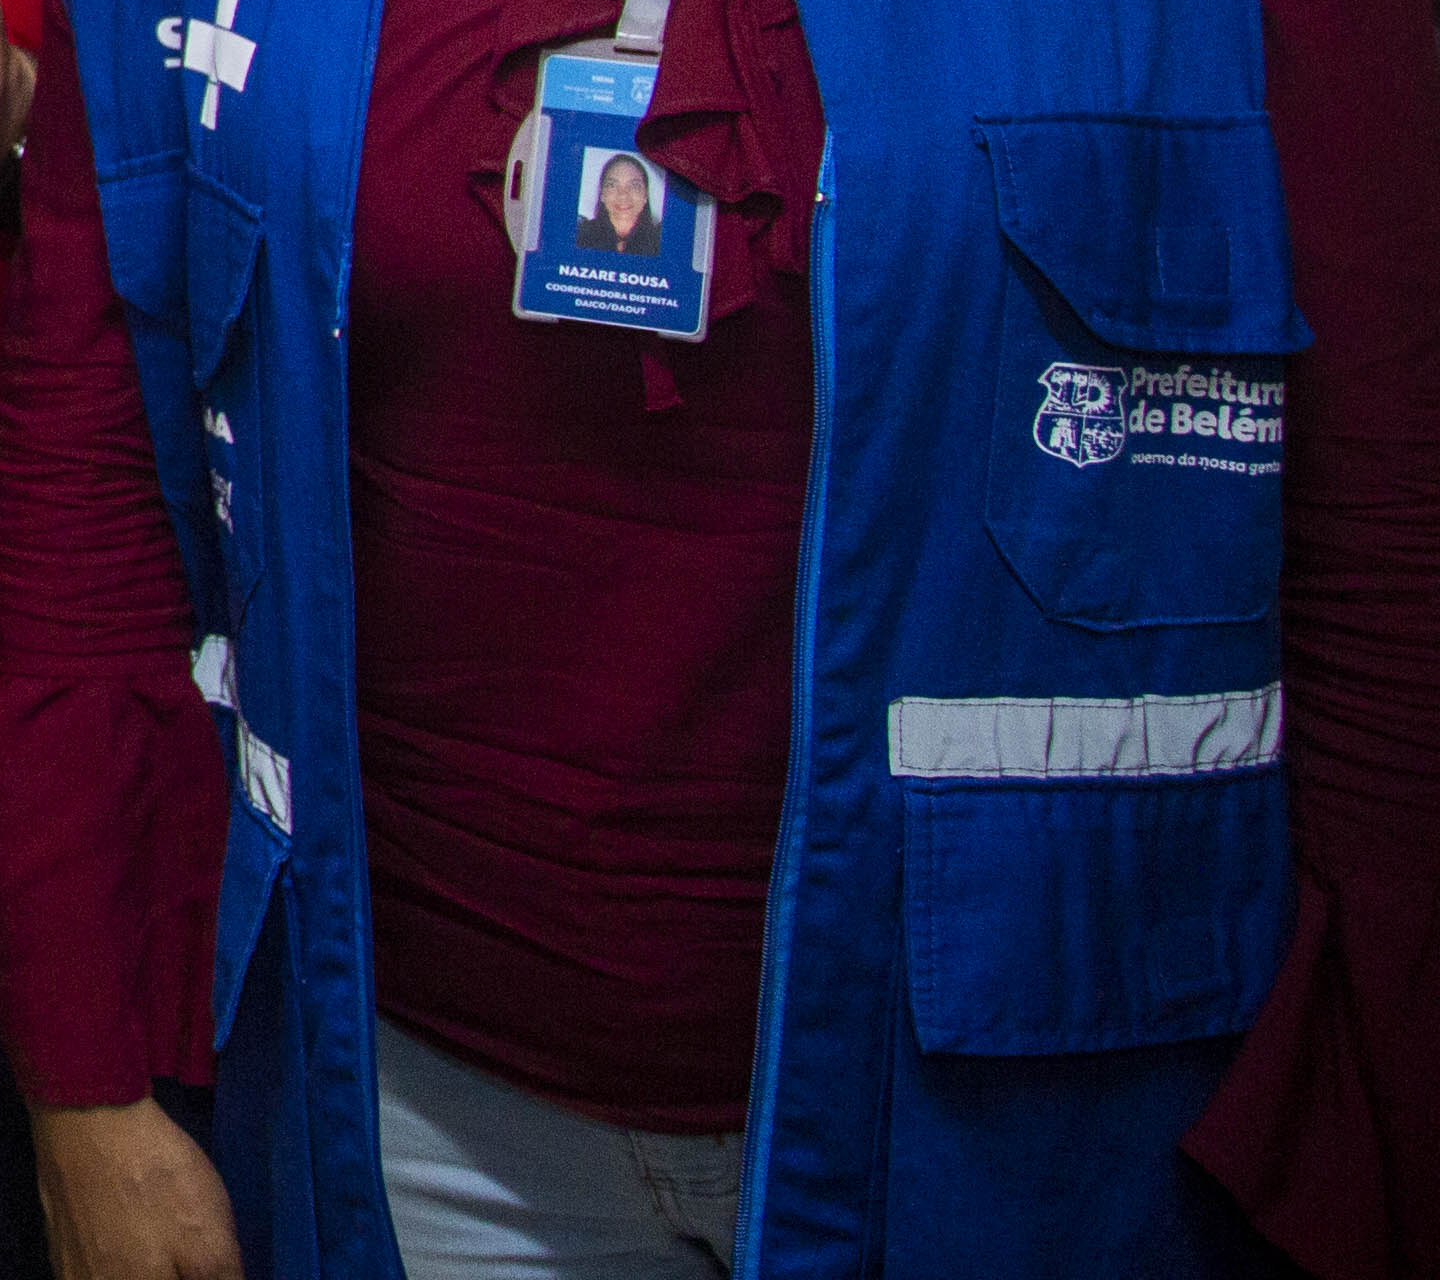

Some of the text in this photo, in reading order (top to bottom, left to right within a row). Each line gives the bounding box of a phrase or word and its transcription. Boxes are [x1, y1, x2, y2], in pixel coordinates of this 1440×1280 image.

[558, 264, 669, 289] NAZARE SOUSA
[545, 282, 679, 308] COORDENADORA DISTRITAL
[1128, 399, 1283, 443] de Belém
[1177, 453, 1197, 467] da
